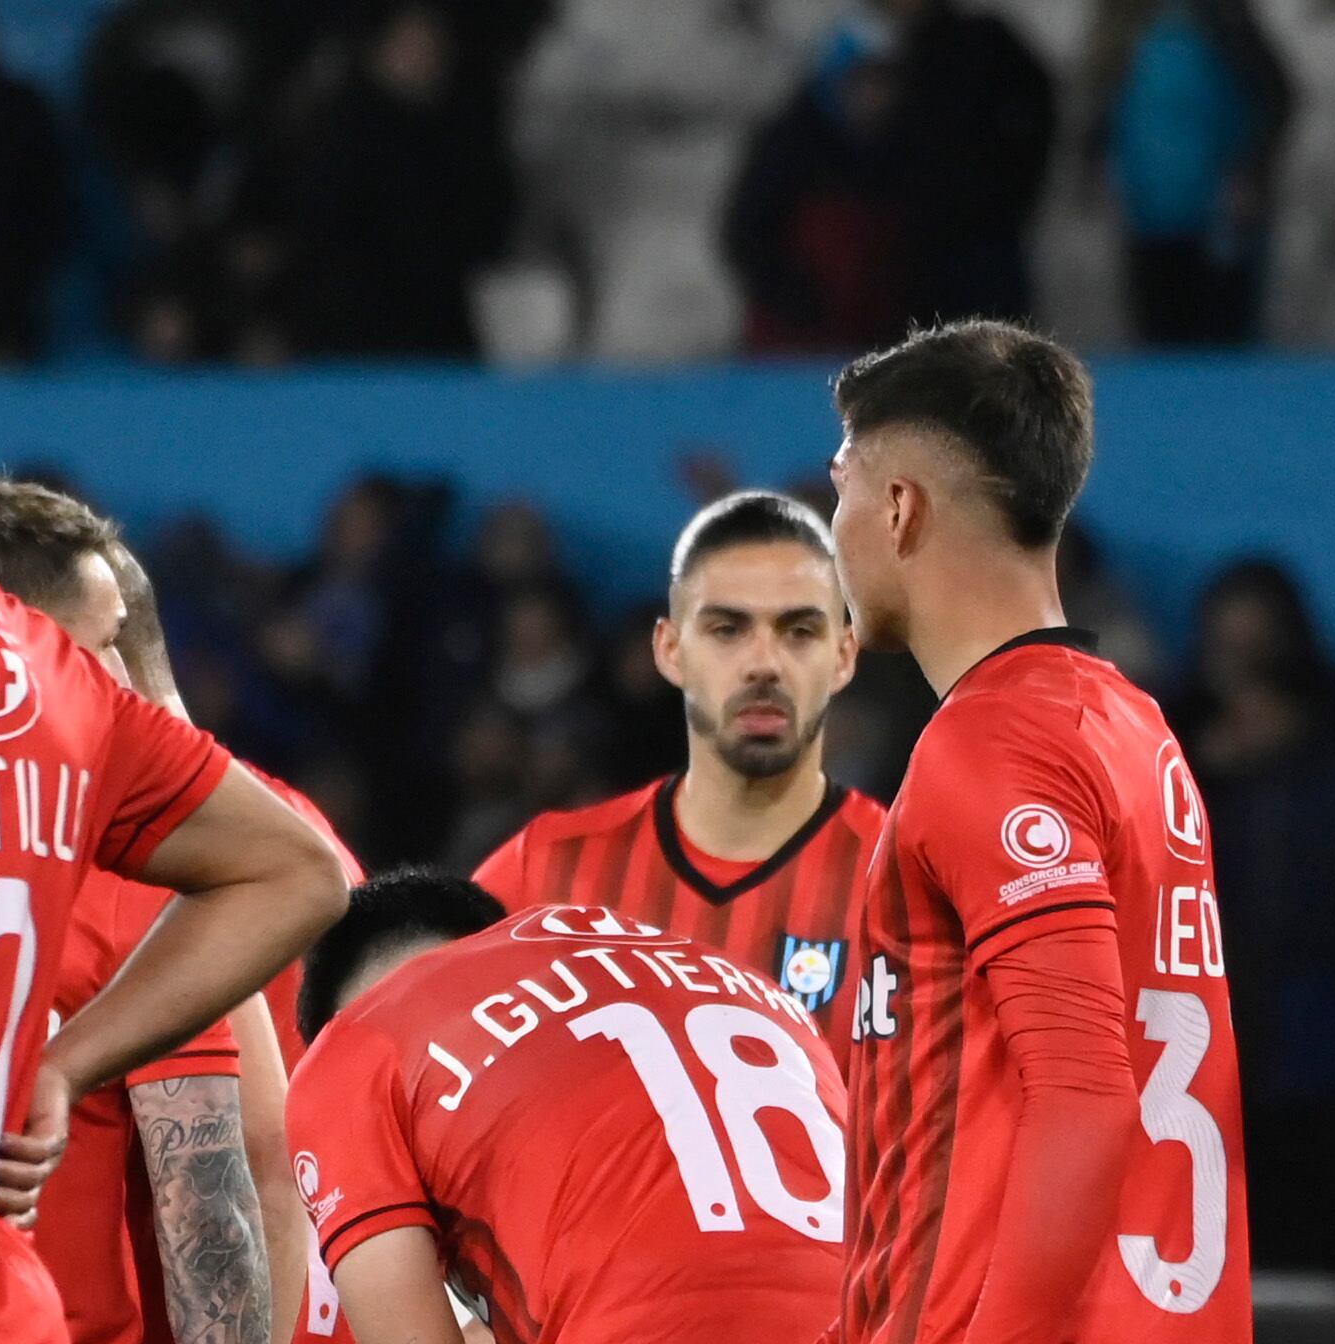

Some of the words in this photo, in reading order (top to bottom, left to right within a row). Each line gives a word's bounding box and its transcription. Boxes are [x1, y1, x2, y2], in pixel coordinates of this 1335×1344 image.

[999, 865, 1067, 898] CONSORCIO
[1069, 861, 1101, 874] CHILE
[566, 1002, 846, 1243] 18
[1118, 987, 1228, 1315] 3
